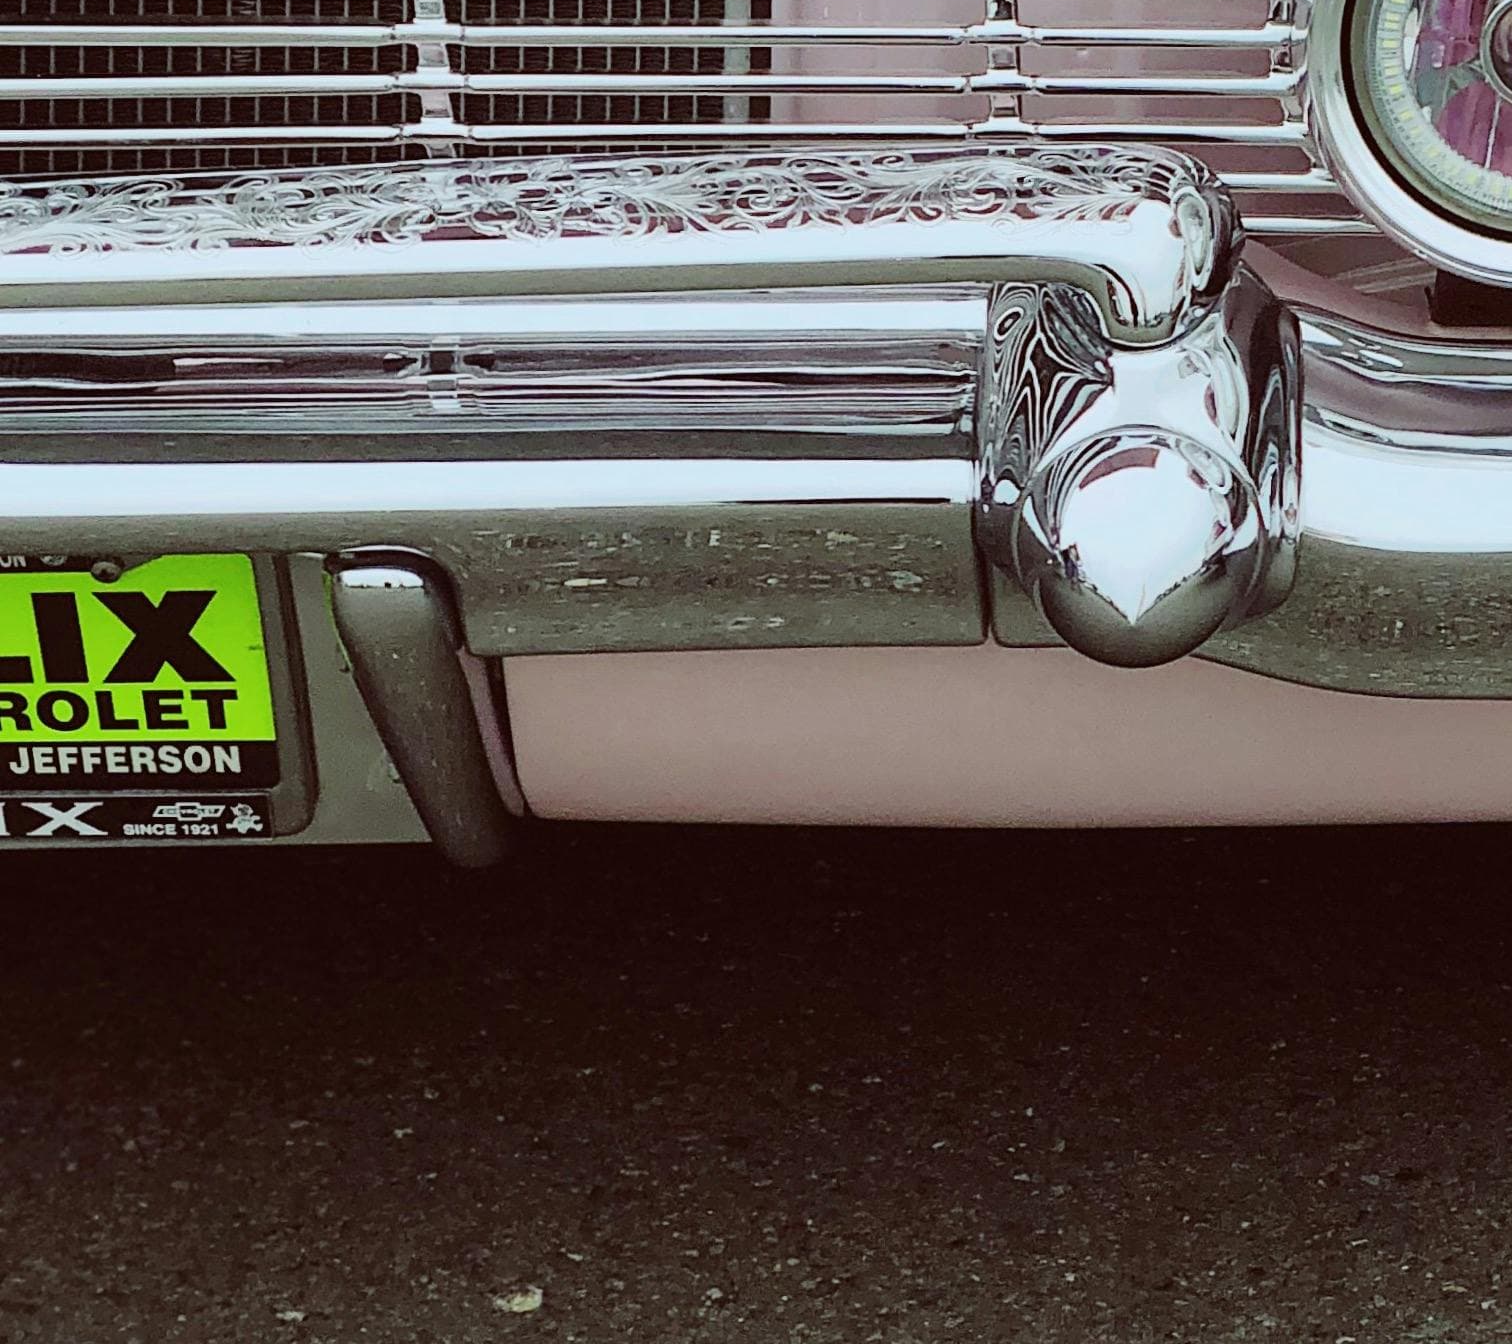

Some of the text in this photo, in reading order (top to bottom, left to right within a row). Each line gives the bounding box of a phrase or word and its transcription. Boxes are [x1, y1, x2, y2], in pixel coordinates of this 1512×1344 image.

[0, 688, 238, 732] ROLET
[9, 745, 242, 775] JEFFERSON
[122, 823, 220, 836] SINCE 1921
